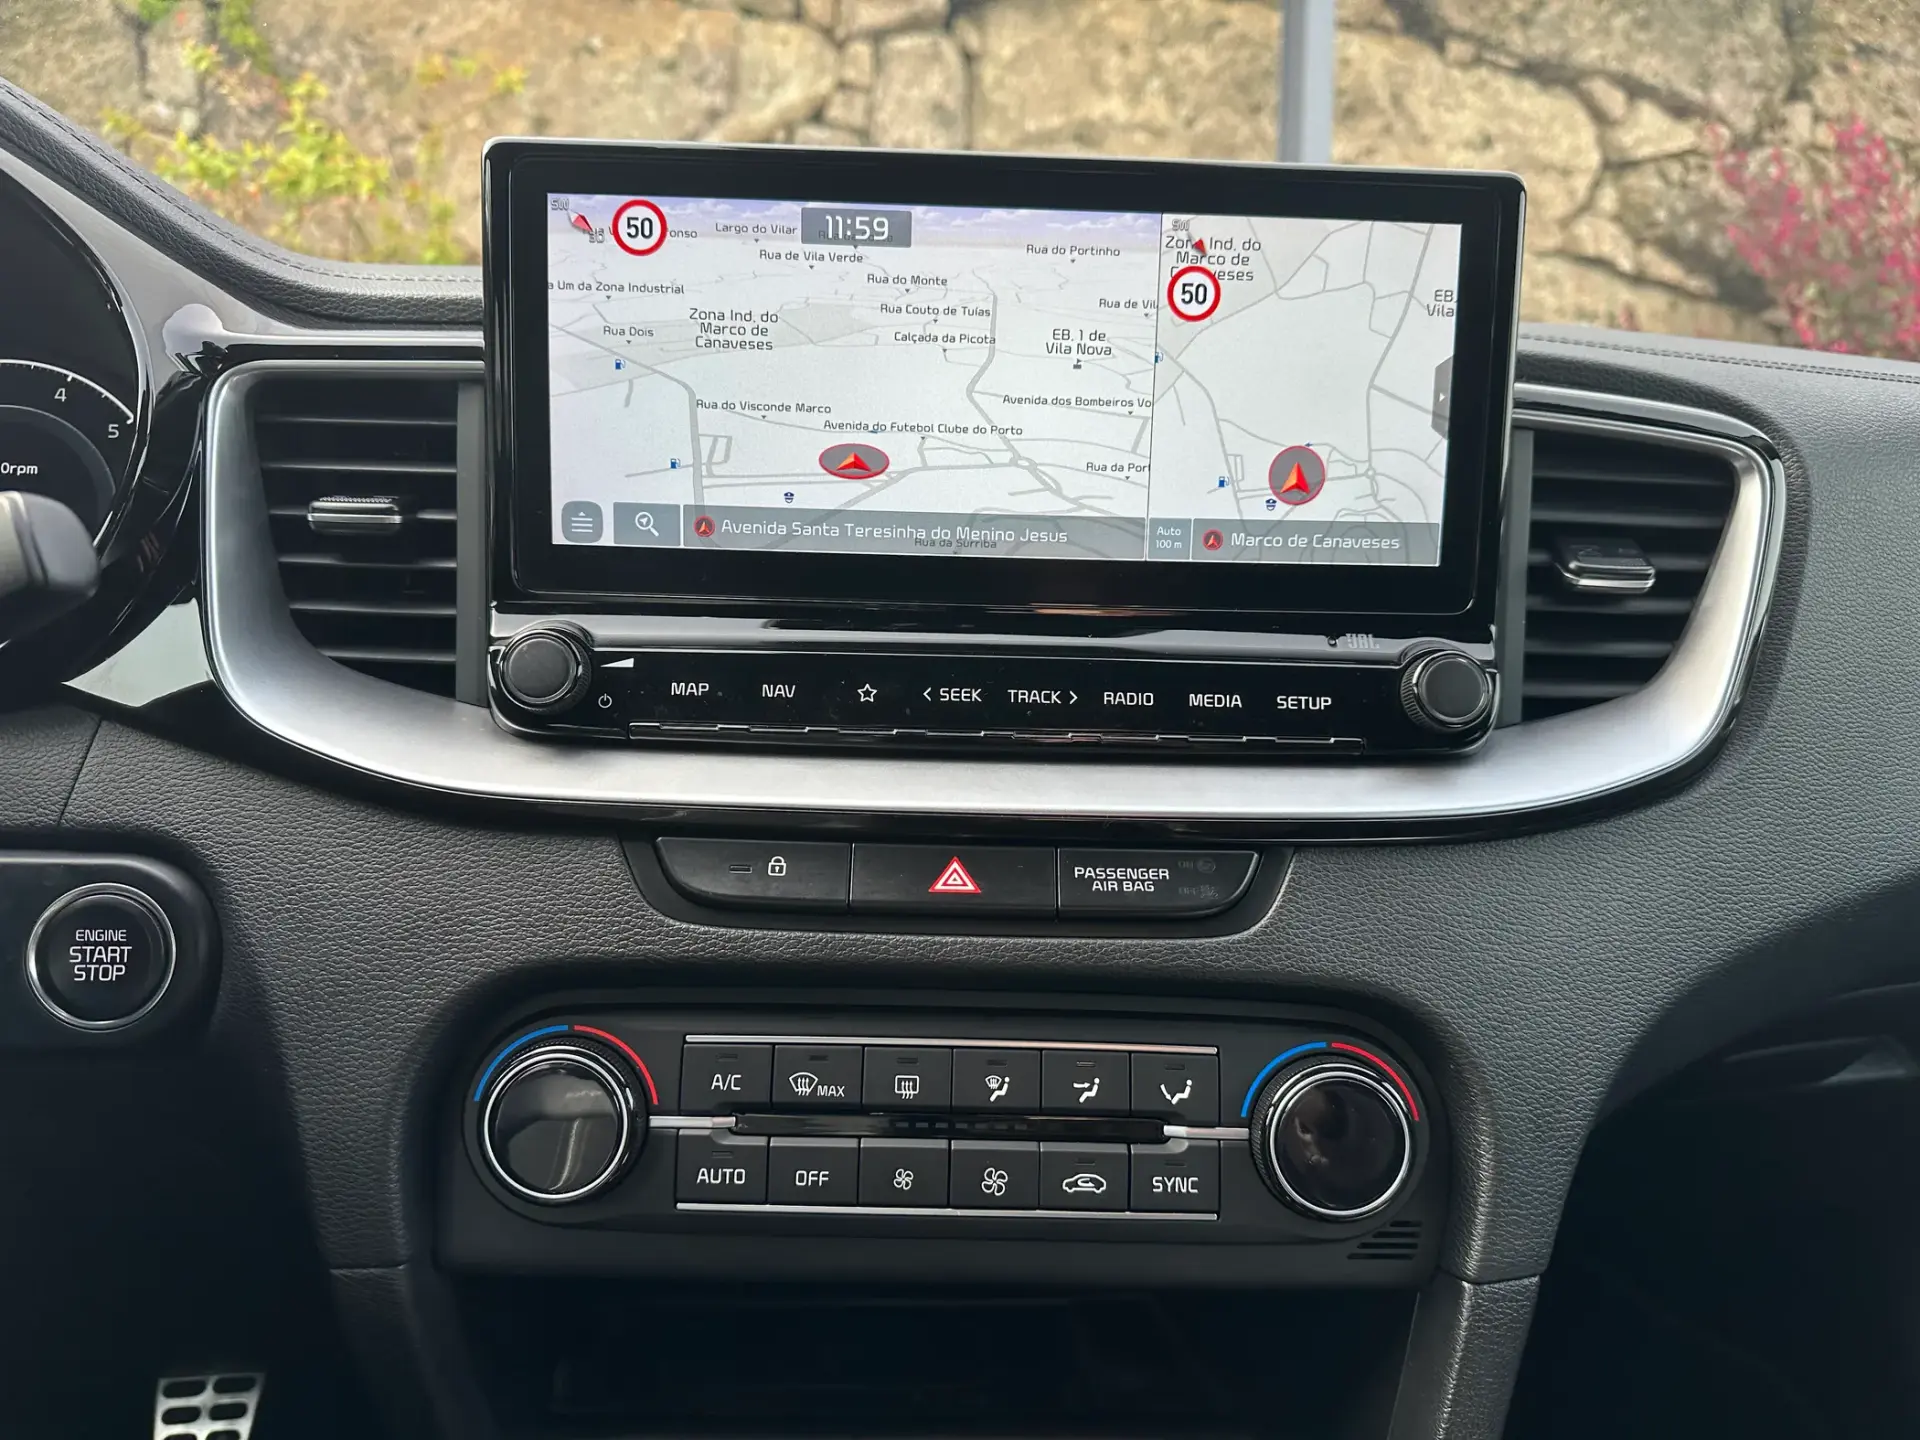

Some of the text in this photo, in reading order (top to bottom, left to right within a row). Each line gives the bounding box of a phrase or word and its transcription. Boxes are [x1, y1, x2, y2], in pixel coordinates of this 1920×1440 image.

[626, 217, 653, 239] 50
[667, 230, 698, 238] onso
[716, 223, 798, 235] Largo do Vilar
[826, 214, 889, 240] 11:59
[1026, 244, 1120, 257] Rua do Portinho
[1166, 236, 1261, 251] Zon Ind. do
[759, 250, 863, 263] Rua de Vila Verde
[1176, 251, 1250, 266] Marco de
[868, 274, 948, 286] Rua do Monte
[1171, 266, 1254, 280] Ceses
[558, 280, 574, 290] Um
[578, 282, 592, 290] da
[596, 282, 624, 292] Zona
[629, 282, 684, 294] Industrial
[1181, 283, 1207, 304] 50
[1099, 298, 1120, 308] Rua
[1124, 298, 1138, 308] de
[690, 308, 778, 323] Zona Ind. do
[880, 304, 990, 317] Rua Couto de Tuías
[1427, 304, 1454, 317] Vila
[604, 326, 654, 337] Rua Dois
[700, 323, 768, 336] Marco de
[1052, 329, 1106, 342] EB. 1 de
[696, 336, 773, 350] Canaveses
[894, 332, 996, 344] Calçada da Picota
[1046, 343, 1112, 356] Vila Nova
[54, 388, 66, 402] 4
[1003, 394, 1048, 405] Avenida
[1052, 396, 1072, 406] dos
[1076, 396, 1134, 407] Bombeiros
[696, 400, 832, 414] Rua do Visconde Marco
[108, 424, 119, 438] 5
[824, 420, 1022, 436] Avenida do Futebol Clube do Porto
[1086, 462, 1107, 472] Rua
[1111, 462, 1124, 472] da
[721, 520, 1068, 542] Avenida Santa Teresinha do Menino Jesus
[1156, 526, 1181, 536] Auto
[915, 538, 936, 547] Rua
[939, 539, 952, 548] da
[1156, 539, 1172, 548] 100
[1232, 532, 1400, 550] Marco de Canaveses
[1346, 633, 1380, 649] JBL
[671, 682, 710, 696] MAP
[762, 684, 796, 698] NAV
[940, 687, 982, 702] SEEK
[1008, 689, 1061, 704] TRACK
[1104, 692, 1154, 706] RADIO
[1189, 693, 1242, 708] MEDIA
[1277, 695, 1332, 710] SETUP
[1074, 866, 1170, 880] PASSENGER
[1092, 881, 1154, 892] AIR BAG
[76, 929, 126, 942] ENGINE
[69, 946, 132, 963] START
[74, 964, 126, 982] STOP
[710, 1073, 742, 1092] A/C
[817, 1085, 845, 1098] MAX
[697, 1168, 746, 1186] AUTO
[796, 1170, 830, 1188] OFF
[1152, 1176, 1199, 1194] SYNC
